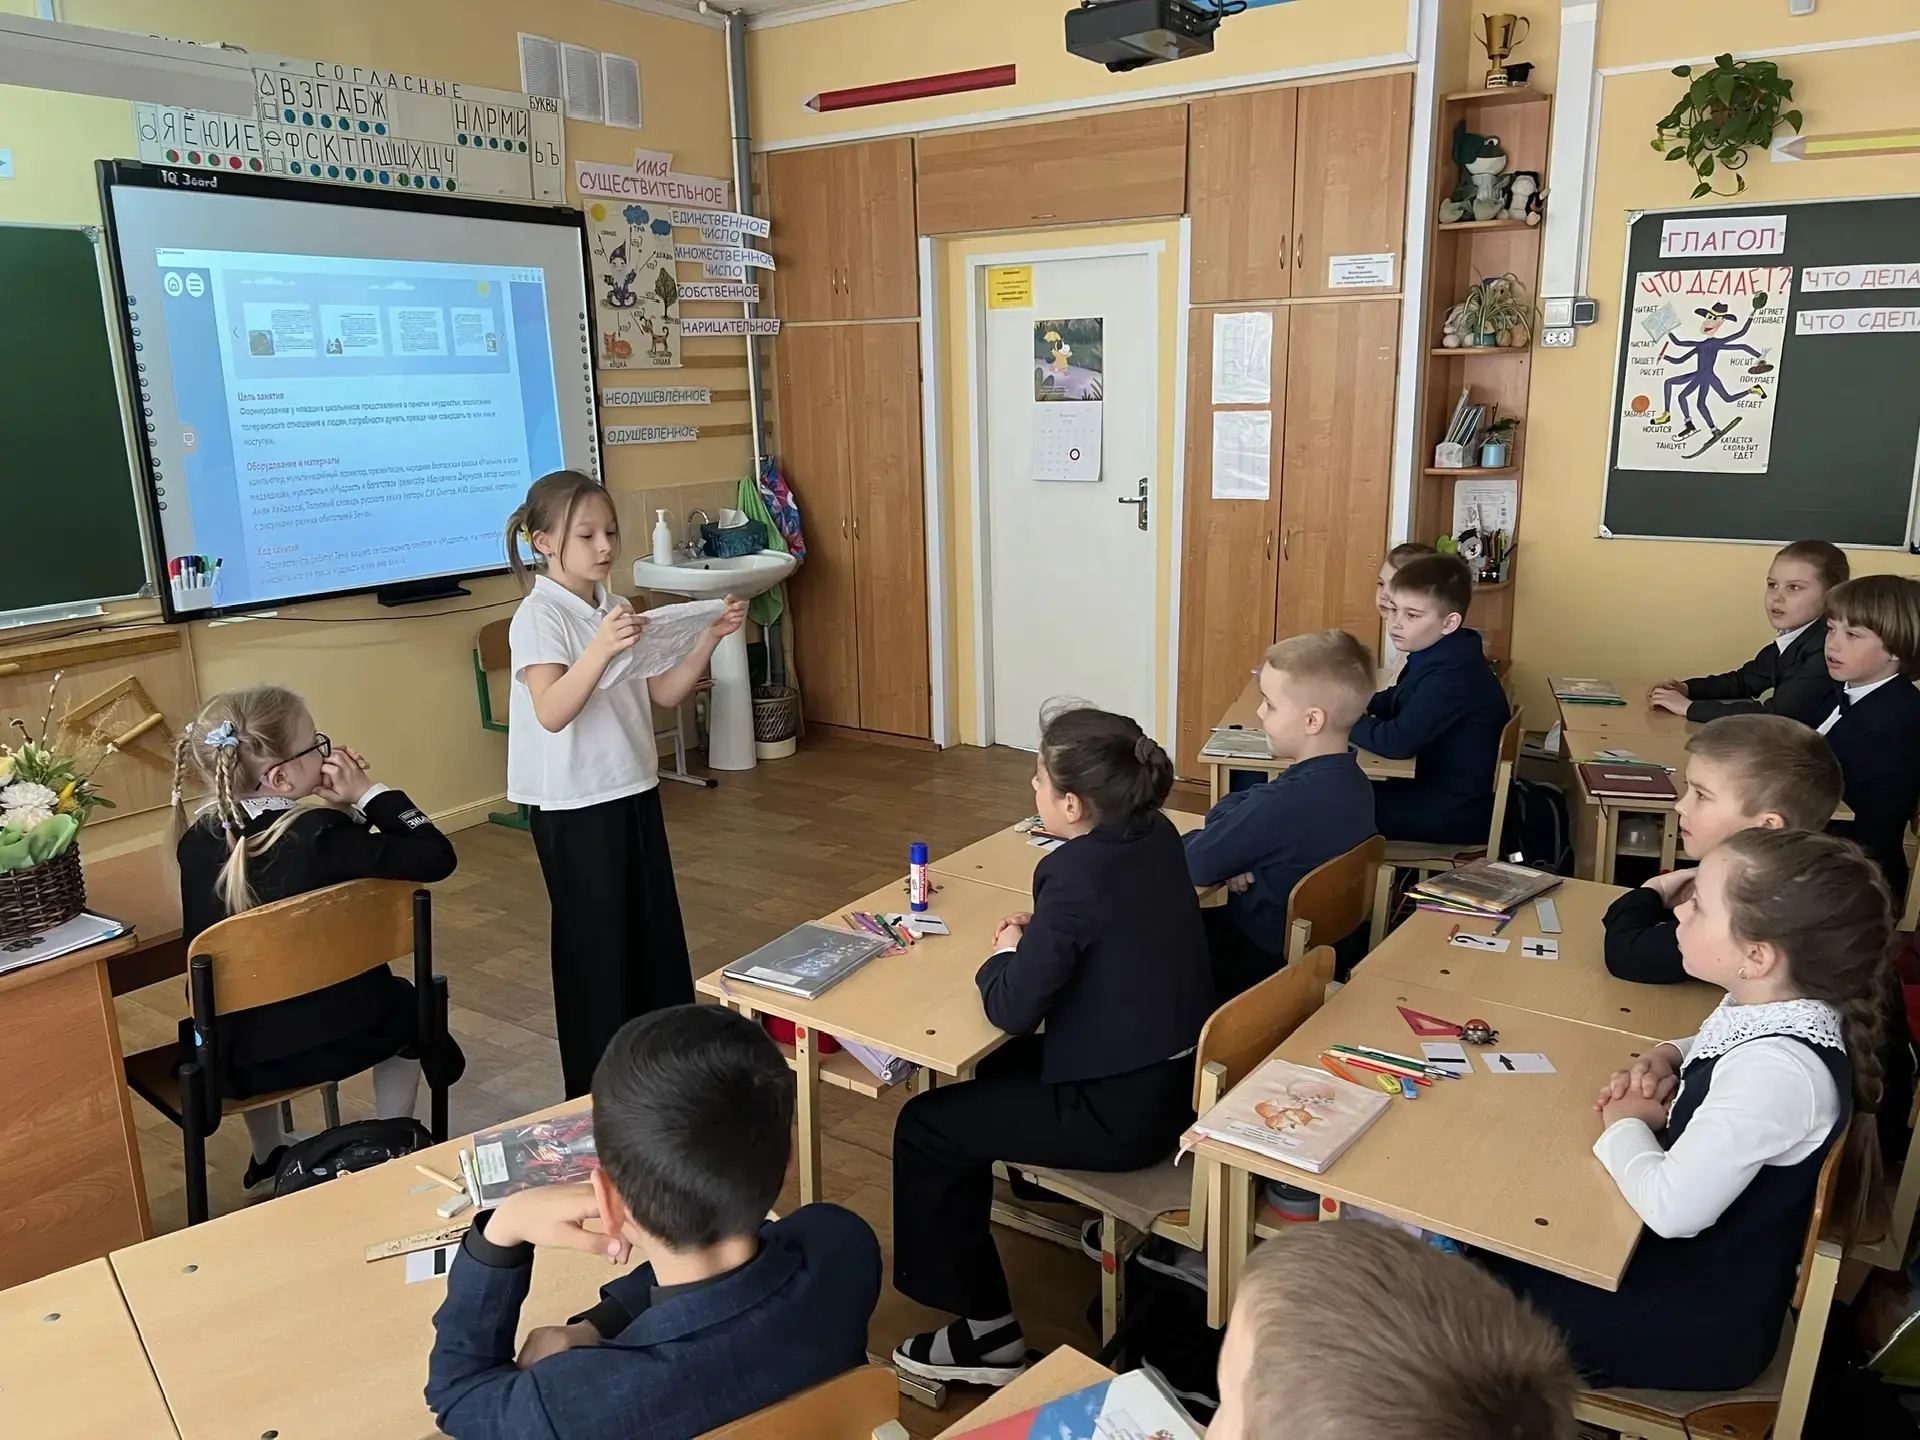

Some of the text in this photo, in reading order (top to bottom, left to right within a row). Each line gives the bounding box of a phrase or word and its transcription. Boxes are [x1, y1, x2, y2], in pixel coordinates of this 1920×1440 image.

[1500, 23, 1511, 49] 1
[529, 96, 558, 112] БУКВЫ
[636, 158, 668, 177] ИМЯ
[579, 171, 723, 204] СУЩЕСТВИТЕЛЬНОЕ
[673, 210, 768, 235] ЕДИНСТВЕННОЕ
[701, 227, 740, 243] ЧИСЛО
[1667, 228, 1776, 252] ГЛАГОЛ
[674, 246, 775, 267] МНОЖЕСТВЕННОЕ
[705, 264, 742, 278] ЧИСЛО
[1641, 265, 1792, 297] ЧТО ДЕЛАЕТ?
[1808, 271, 1850, 287] ЧТО
[678, 285, 758, 298] СОБСТВЕННОЕ
[1634, 305, 1658, 314] ЧИТАЕТ
[1759, 308, 1784, 316] ИГРАЕТ
[682, 320, 779, 334] НАРИЦАТЕЛЬНОЕ
[1802, 311, 1920, 331] ЧТО СДЕЛ
[1631, 357, 1655, 365] ПИШЕТ
[1730, 358, 1754, 366] НОСИТ
[1640, 368, 1664, 376] РИСУЕТ
[1740, 376, 1775, 384] ПОКУПАЕТ
[237, 392, 255, 400] Цель
[606, 389, 706, 405] НЕОДУШЕВЛЁННОЕ
[1736, 401, 1762, 409] БЕГАЕТ
[1656, 442, 1687, 450] ТАНЦУЕТ
[1733, 452, 1753, 460] ЕДЕТ
[246, 460, 296, 471] Оборудование
